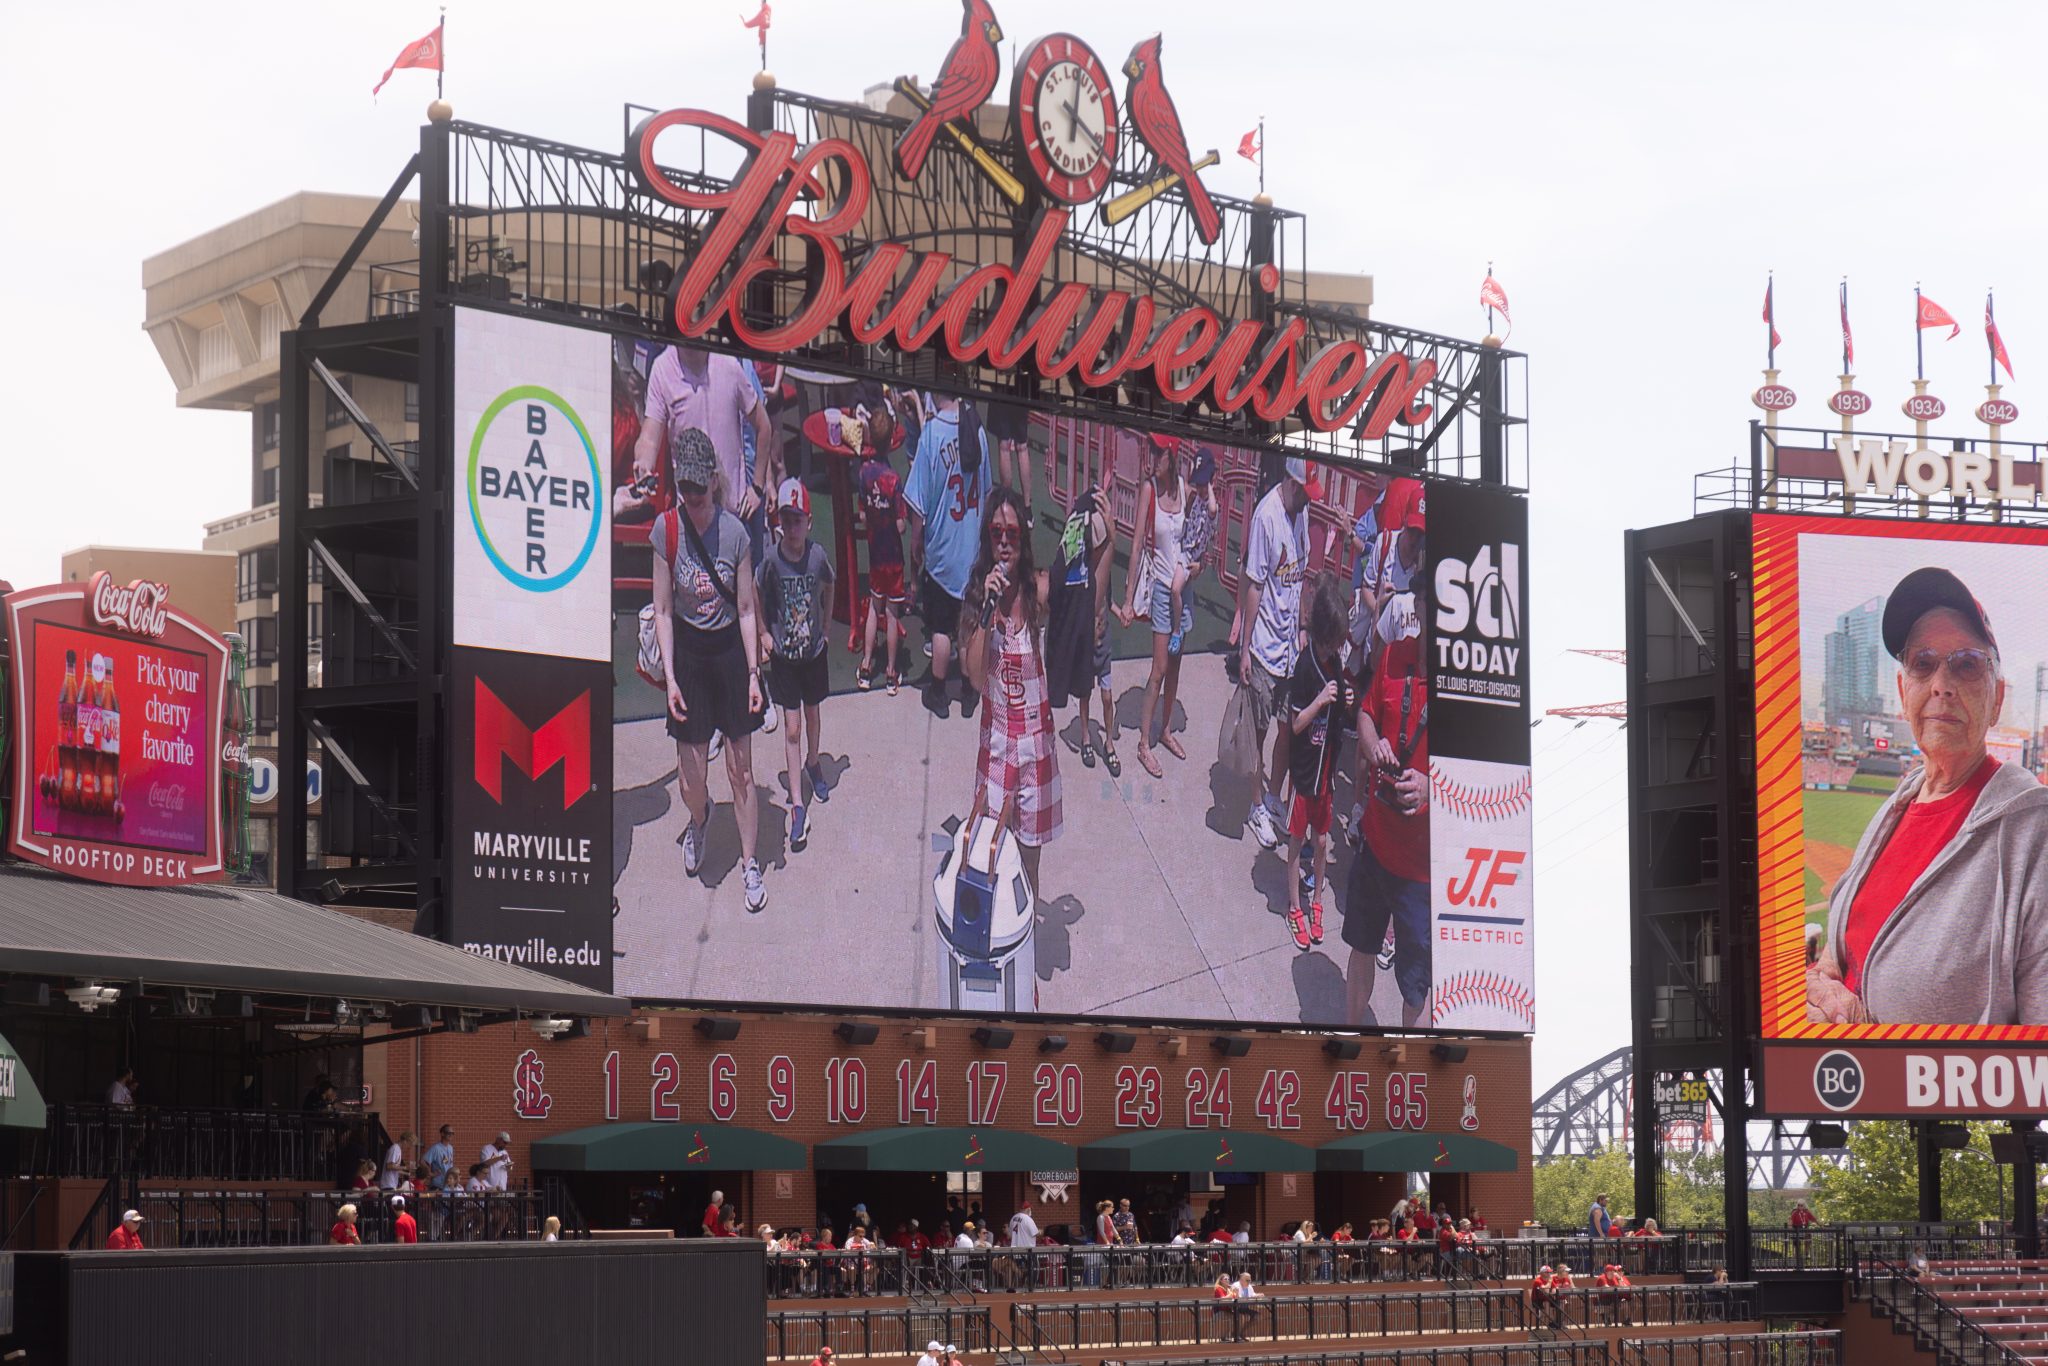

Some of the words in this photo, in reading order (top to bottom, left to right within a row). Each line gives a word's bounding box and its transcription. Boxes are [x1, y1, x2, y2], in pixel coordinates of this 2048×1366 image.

[1046, 71, 1062, 93] ST.
[1064, 65, 1099, 104] LOUIS
[634, 106, 1439, 440] Budweiser
[1759, 388, 1794, 406] 1926
[1836, 394, 1867, 411] 1931
[1909, 399, 1943, 416] 1934
[1982, 404, 2015, 421] 1942
[481, 465, 591, 511] BAYER
[1833, 438, 2048, 503] WORL
[524, 404, 548, 575] BAYER
[948, 473, 979, 522] 34
[137, 655, 166, 686] Pick
[168, 668, 199, 695] your
[1436, 637, 1520, 677] TODAY
[1436, 674, 1448, 689] ST.
[1447, 676, 1468, 692] LOUIS
[1469, 679, 1520, 698] POST-DISPATCH
[145, 693, 191, 733] cherry
[142, 729, 194, 766] favorite
[52, 843, 135, 872] ROOFTOP
[143, 854, 187, 879] DECK
[474, 831, 591, 863] MARYVILLE
[474, 866, 590, 885] UNIVERSITY
[1447, 847, 1527, 909] J.F.
[463, 938, 601, 967] maryville.edu
[1440, 927, 1524, 945] ELECTRIC
[603, 1051, 619, 1120] 1
[652, 1053, 680, 1121] 2
[709, 1054, 737, 1121] 6
[768, 1056, 795, 1122] 9
[825, 1058, 866, 1123] 10
[896, 1059, 938, 1124] 14
[966, 1061, 1007, 1125] 17
[1034, 1063, 1082, 1126] 20
[1115, 1066, 1162, 1127] 23
[1186, 1068, 1232, 1128] 24
[1256, 1070, 1301, 1129] 42
[1326, 1072, 1369, 1130] 45
[1386, 1073, 1427, 1130] 85
[1656, 1081, 1708, 1102] bet365
[1822, 1067, 1856, 1094] BC
[1906, 1055, 2048, 1108] BROW
[1033, 1171, 1077, 1181] SCOREBOARD
